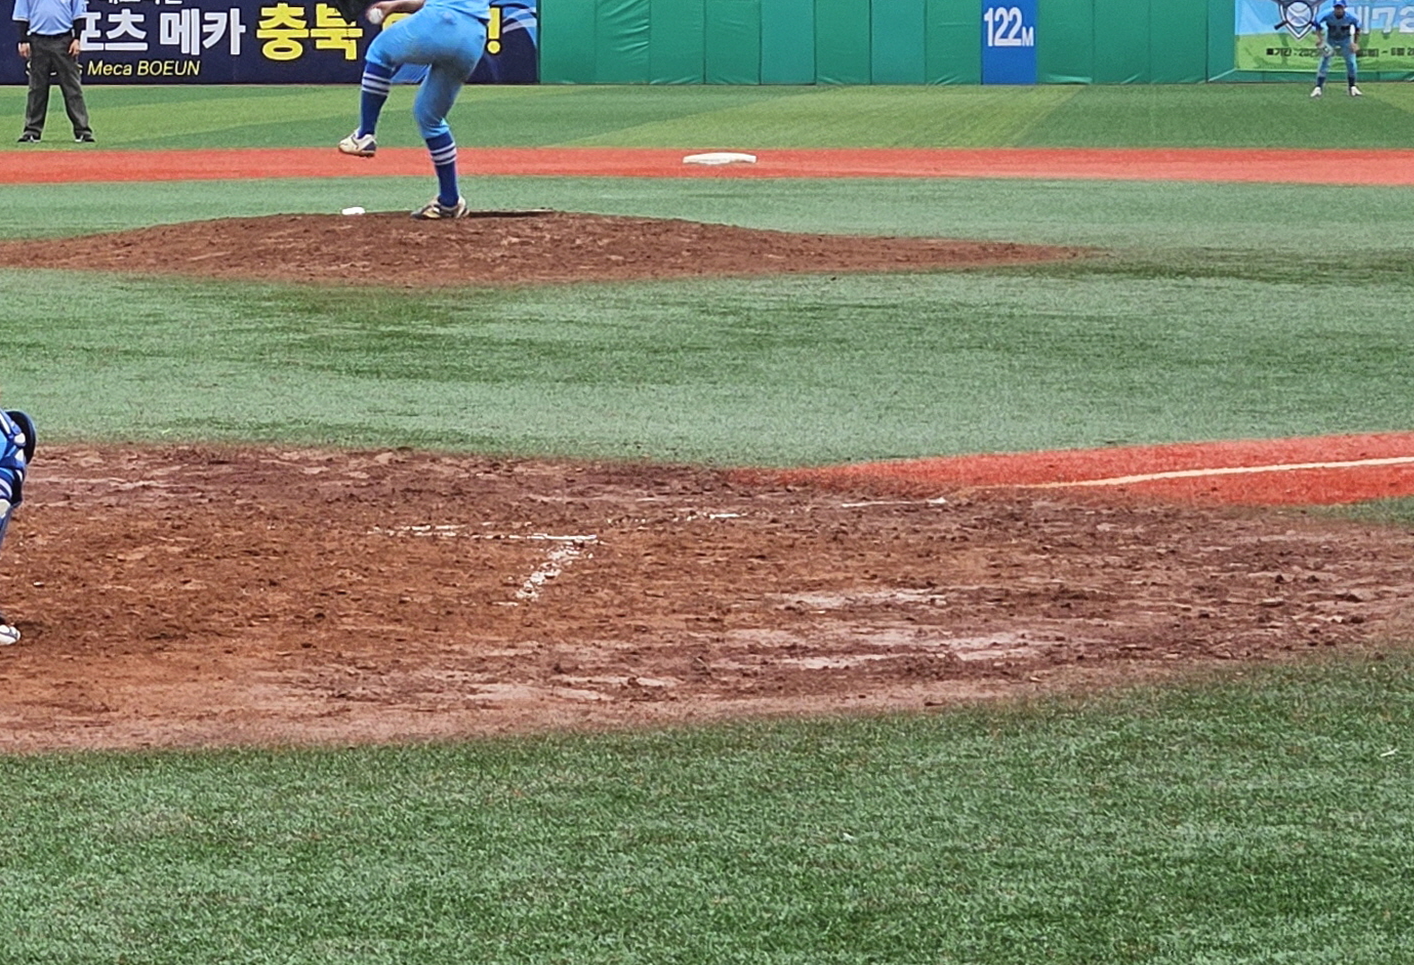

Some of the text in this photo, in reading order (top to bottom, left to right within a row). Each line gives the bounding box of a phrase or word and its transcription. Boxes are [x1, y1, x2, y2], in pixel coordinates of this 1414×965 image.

[80, 8, 149, 52] 포츠
[158, 6, 247, 57] 메카
[255, 1, 365, 62] 충북
[87, 60, 133, 77] Meca
[136, 60, 201, 77] BOEUN
